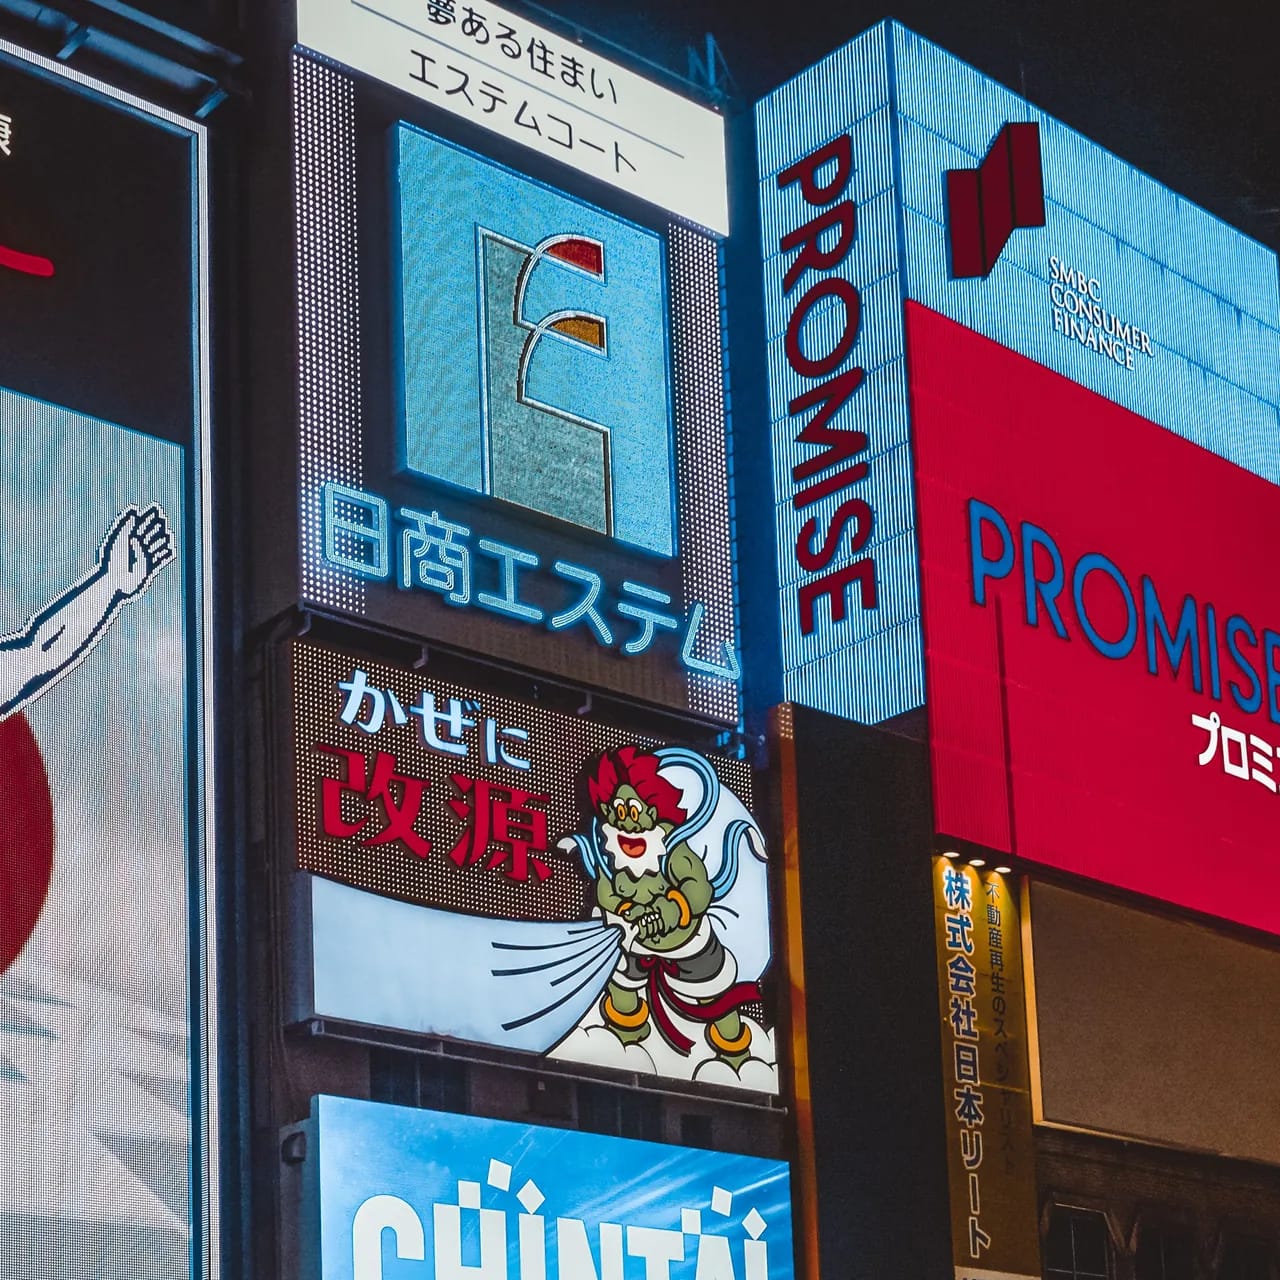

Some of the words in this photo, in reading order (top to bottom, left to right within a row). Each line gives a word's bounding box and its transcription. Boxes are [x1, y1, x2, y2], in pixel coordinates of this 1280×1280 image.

[408, 48, 637, 174] エステムコート
[1048, 255, 1102, 304] SMBC
[1049, 281, 1154, 359] CONSUMER
[1051, 307, 1136, 371] FINANCE
[777, 133, 878, 637] PROMISE
[322, 480, 741, 681] 日商エステム
[337, 667, 532, 772] かぜに
[315, 745, 554, 884] 改源
[942, 869, 992, 1260] 株式会社日本リート
